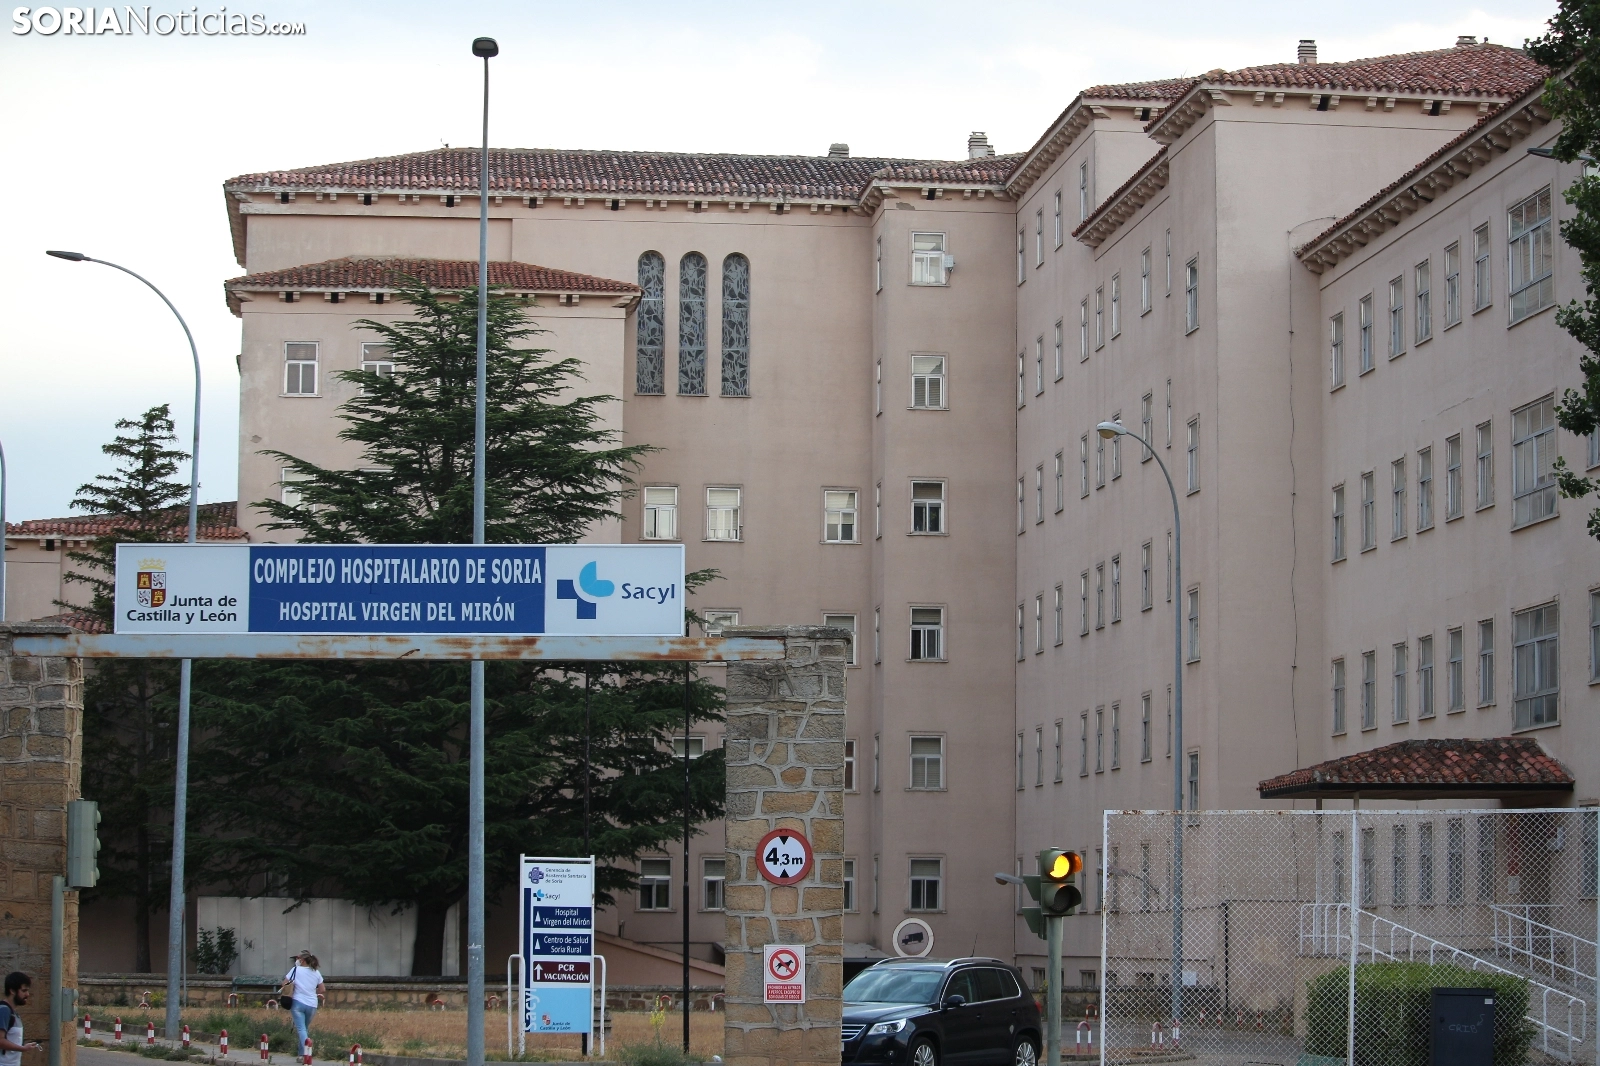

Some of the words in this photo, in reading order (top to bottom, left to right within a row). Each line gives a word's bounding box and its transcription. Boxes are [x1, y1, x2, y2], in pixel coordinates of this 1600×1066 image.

[254, 558, 336, 584] COMPLEJO
[341, 558, 460, 584] HOSPITALARIO
[465, 558, 485, 584] DE
[491, 558, 542, 584] SORIA
[621, 582, 675, 604] Sacyl
[170, 595, 213, 607] Junta
[217, 595, 237, 607] de
[279, 602, 356, 621] HOSPITAL
[361, 602, 421, 621] VIRGEN
[427, 602, 456, 621] DEL
[461, 596, 515, 622] MIRÓN
[126, 609, 181, 622] Castilla
[184, 611, 195, 625] y
[200, 609, 237, 622] León
[555, 908, 579, 917] Hospital
[543, 917, 561, 927] Virgen
[562, 917, 572, 926] del
[572, 917, 591, 926] Mirón
[543, 935, 564, 944] Centro
[564, 935, 572, 944] de
[572, 935, 589, 944] Salud
[551, 945, 566, 953] Soria
[566, 945, 582, 953] Rural
[558, 963, 575, 971] PCR
[544, 972, 589, 980] VACUNACIÓN
